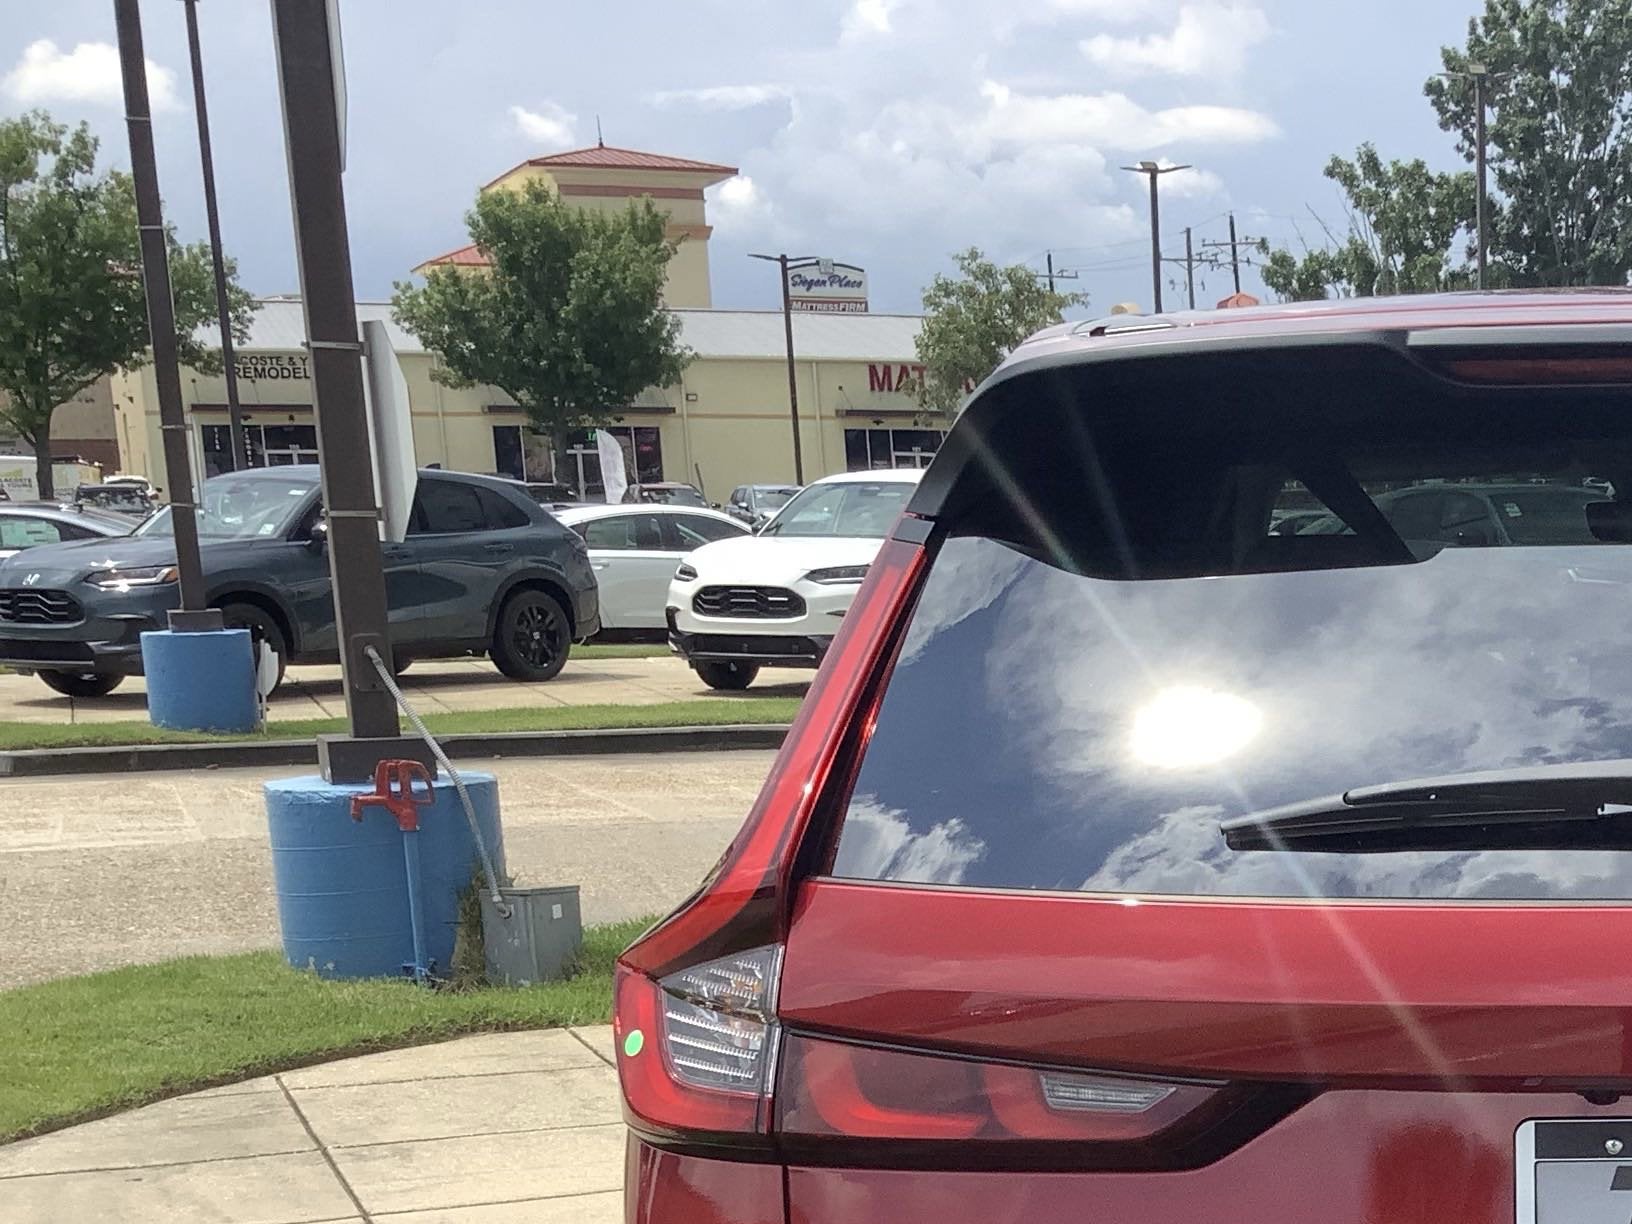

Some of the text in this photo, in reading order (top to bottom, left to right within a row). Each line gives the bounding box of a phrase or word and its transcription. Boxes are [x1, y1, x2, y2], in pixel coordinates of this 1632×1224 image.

[828, 274, 863, 288] Place
[239, 356, 284, 366] COSTE
[236, 367, 311, 379] REMODEL
[868, 364, 927, 392] MAT
